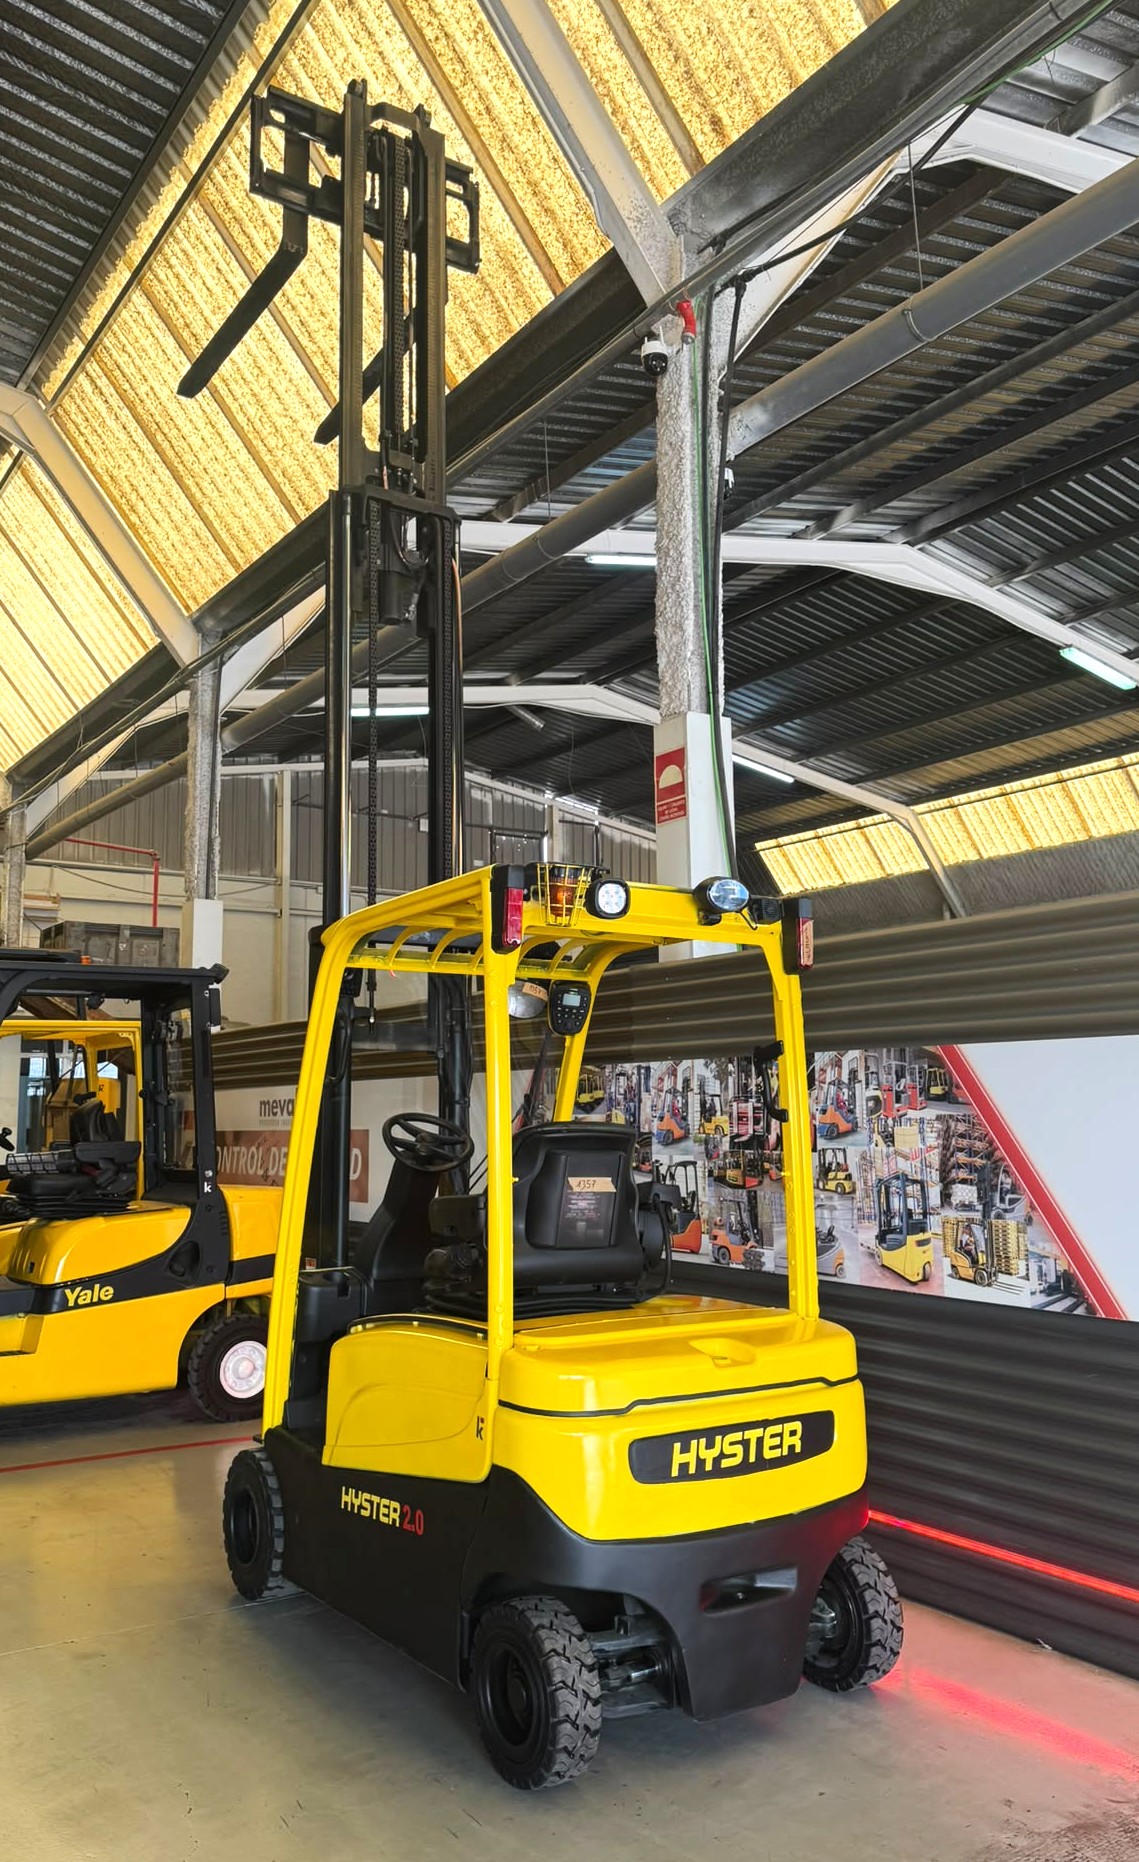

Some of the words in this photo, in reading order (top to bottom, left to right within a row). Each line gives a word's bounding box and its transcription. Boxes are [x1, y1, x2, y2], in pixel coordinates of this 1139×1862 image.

[259, 1093, 296, 1118] meva
[216, 1145, 263, 1175] ONTROL
[268, 1146, 288, 1176] DE
[576, 1179, 597, 1191] 1357
[64, 1283, 114, 1307] Yale
[671, 1420, 803, 1478] HYSTER
[341, 1485, 401, 1528] HYSTER
[402, 1504, 424, 1536] 2.0
